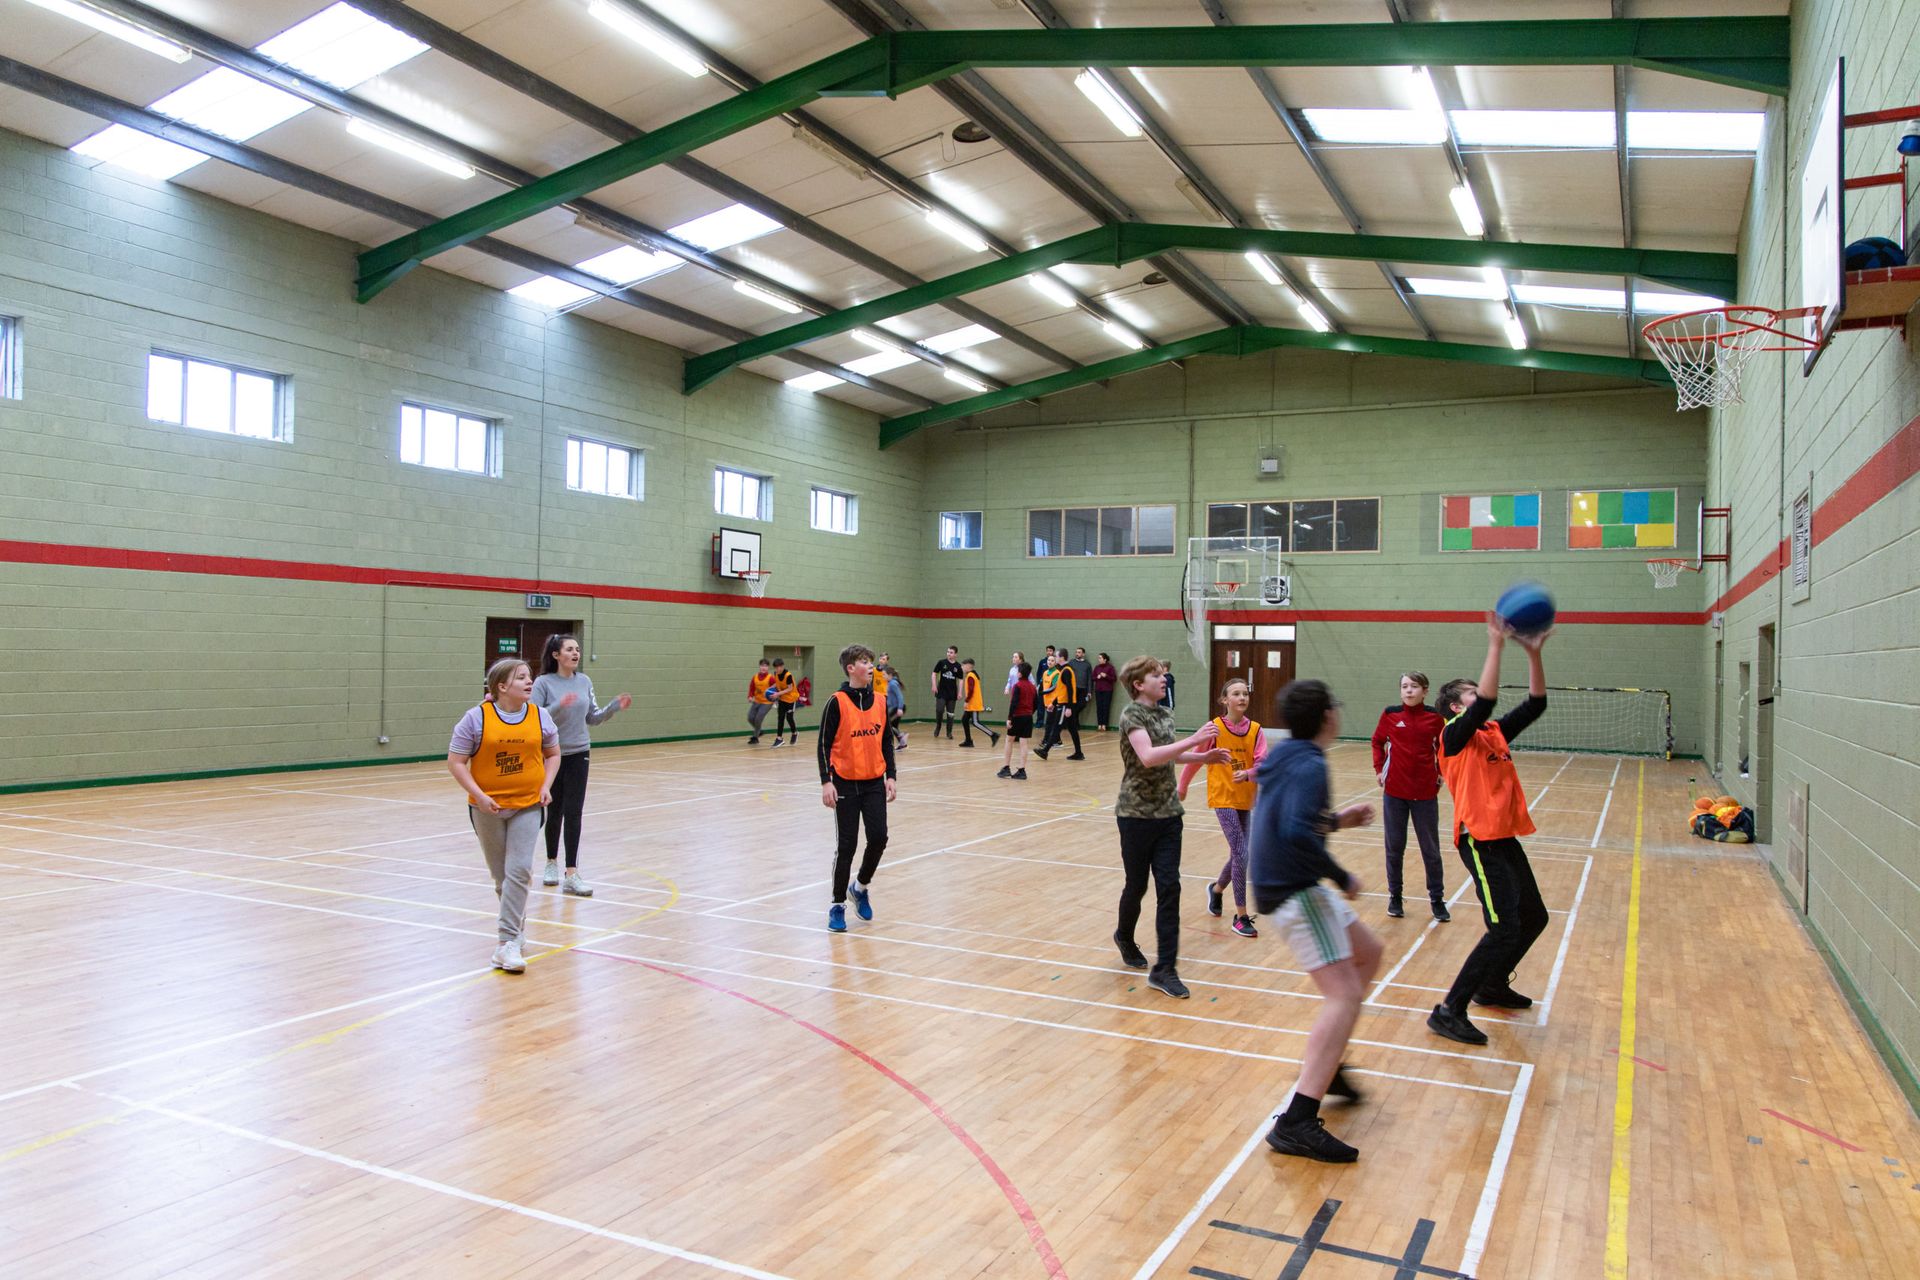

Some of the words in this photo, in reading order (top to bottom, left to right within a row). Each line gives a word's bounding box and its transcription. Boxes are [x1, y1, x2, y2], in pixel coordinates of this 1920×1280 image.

[851, 729, 876, 738] JAKO
[496, 756, 520, 767] SUPER
[500, 763, 524, 774] TOUCH
